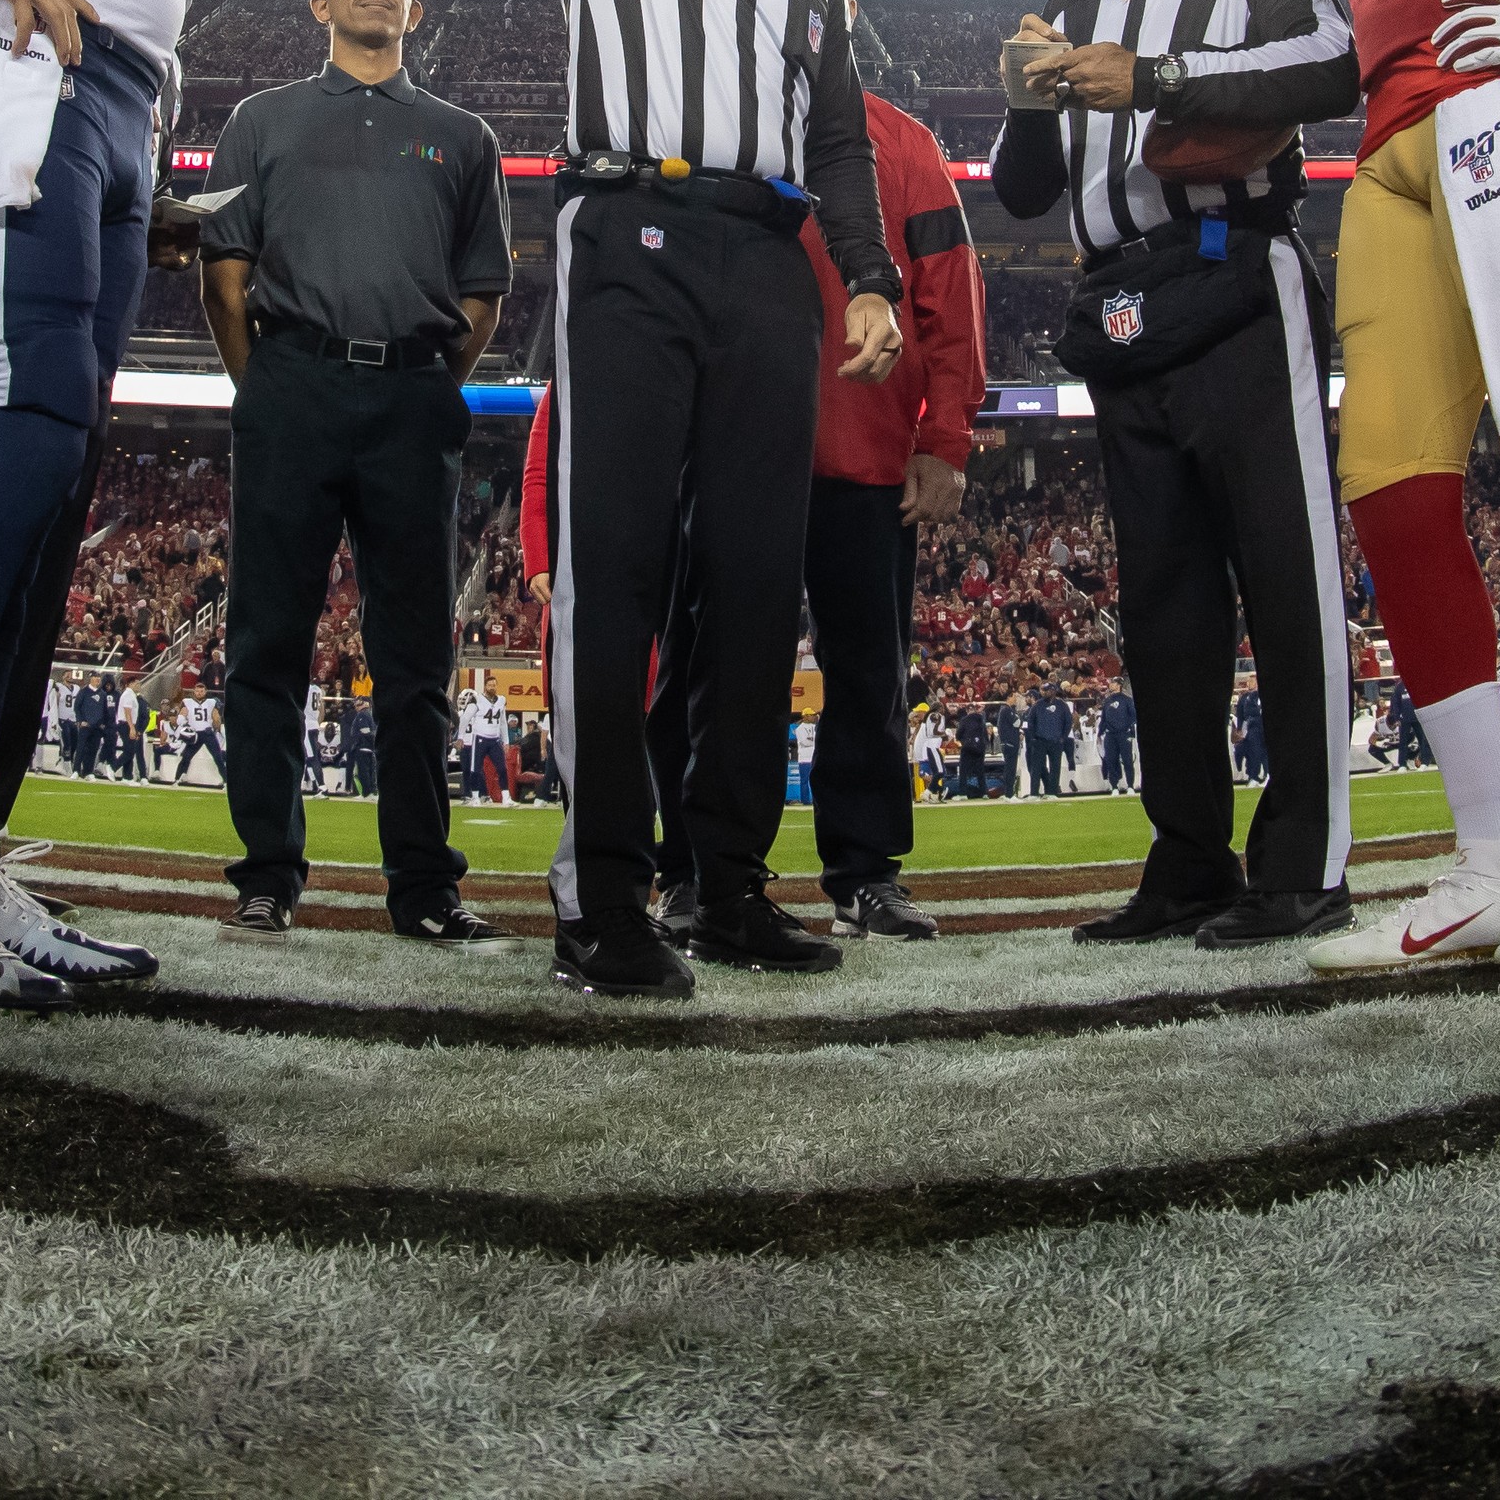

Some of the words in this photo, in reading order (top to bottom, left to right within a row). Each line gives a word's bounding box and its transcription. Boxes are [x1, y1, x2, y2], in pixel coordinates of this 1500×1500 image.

[0, 37, 45, 62] Wson
[183, 153, 202, 165] TO
[1473, 166, 1492, 180] NFL
[644, 235, 661, 246] NFL
[1107, 309, 1138, 337] NFL
[194, 707, 208, 722] 51
[484, 708, 501, 724] 44
